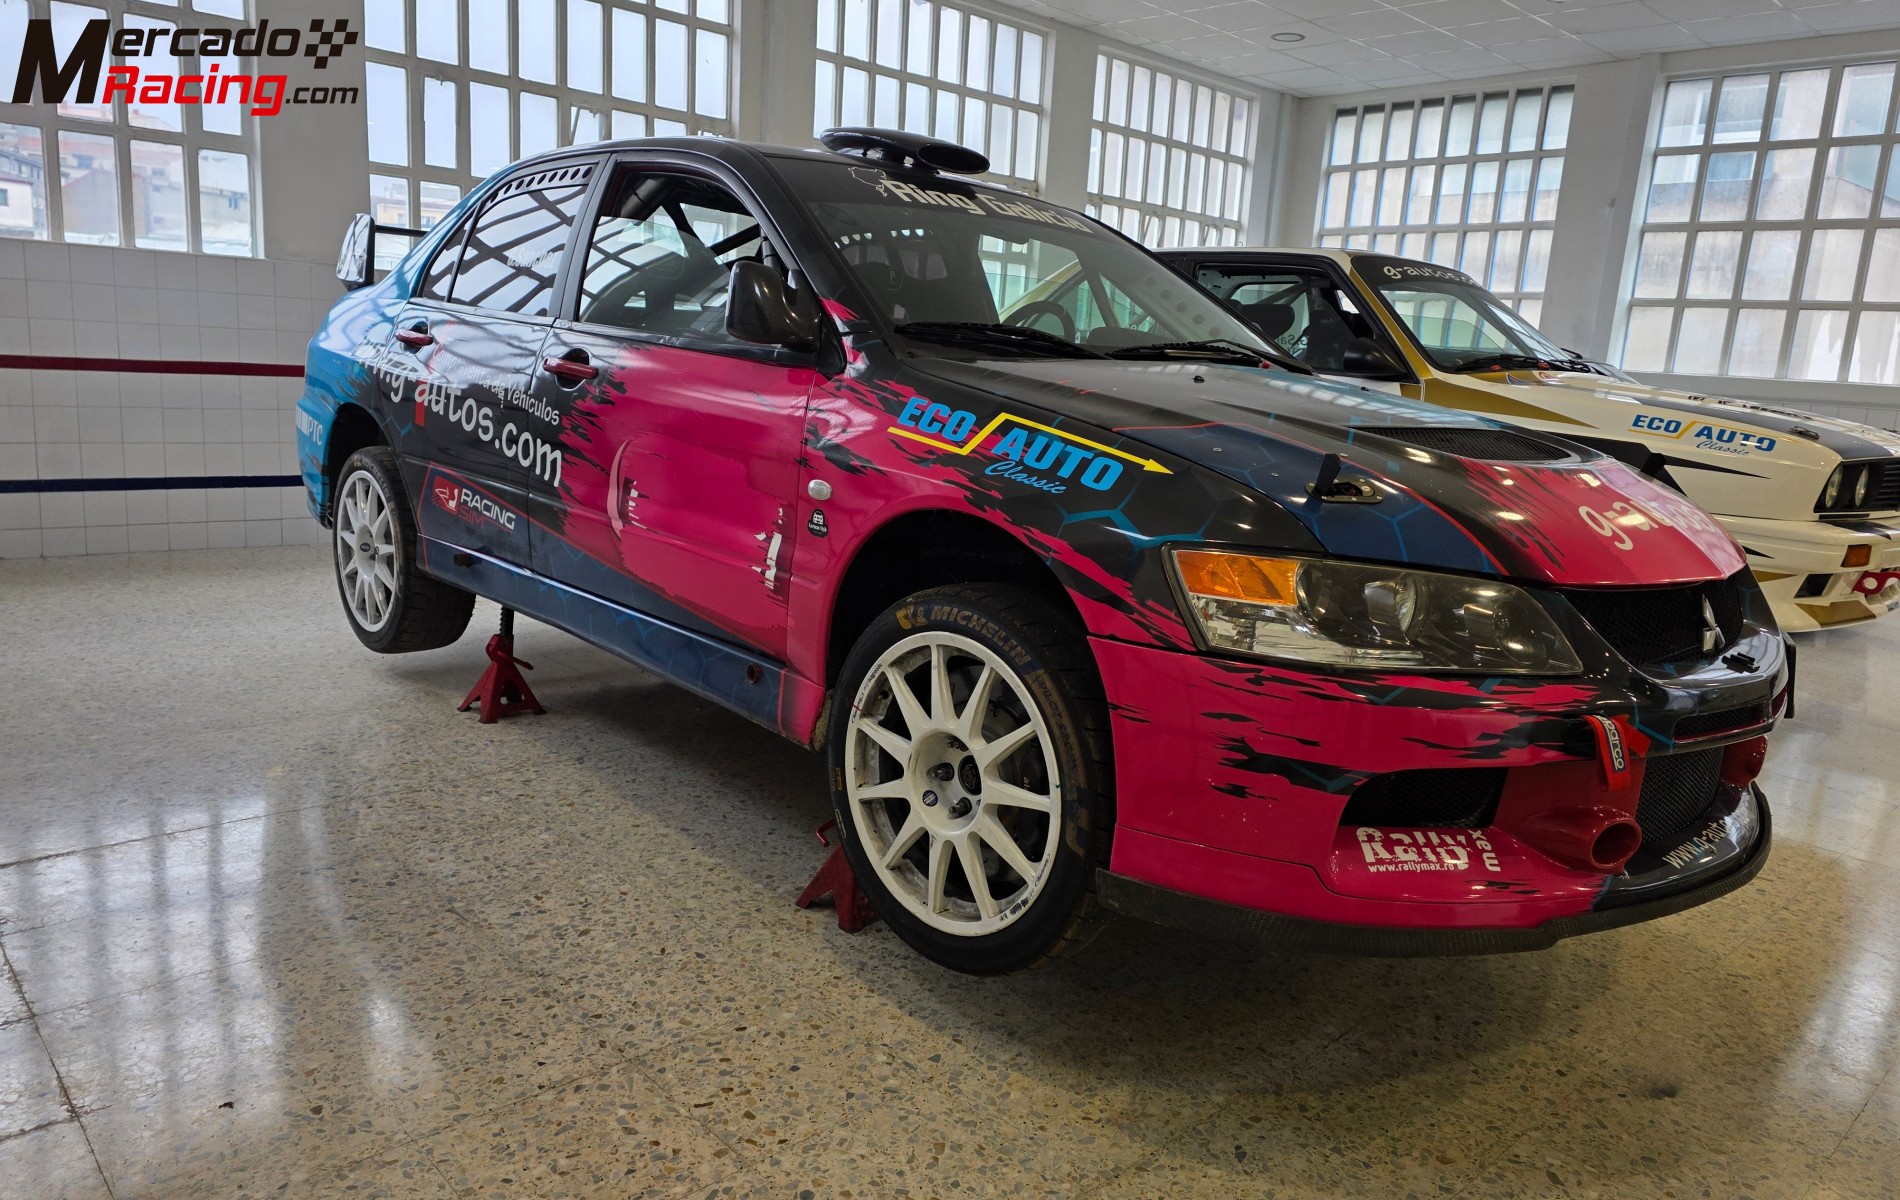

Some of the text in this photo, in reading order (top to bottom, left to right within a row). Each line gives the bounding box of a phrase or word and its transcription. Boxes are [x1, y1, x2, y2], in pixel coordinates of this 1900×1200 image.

[879, 179, 1094, 233] Ring Galicia
[897, 396, 1124, 491] ECO AUTO
[1632, 414, 1777, 452] ECO AUTO
[1695, 438, 1750, 456] Classic
[984, 460, 1067, 495] Classic
[460, 488, 516, 530] RACING
[930, 606, 1032, 666] MICHELIN
[1356, 827, 1469, 870] Rally
[1367, 861, 1455, 873] www.rallymax.ro
